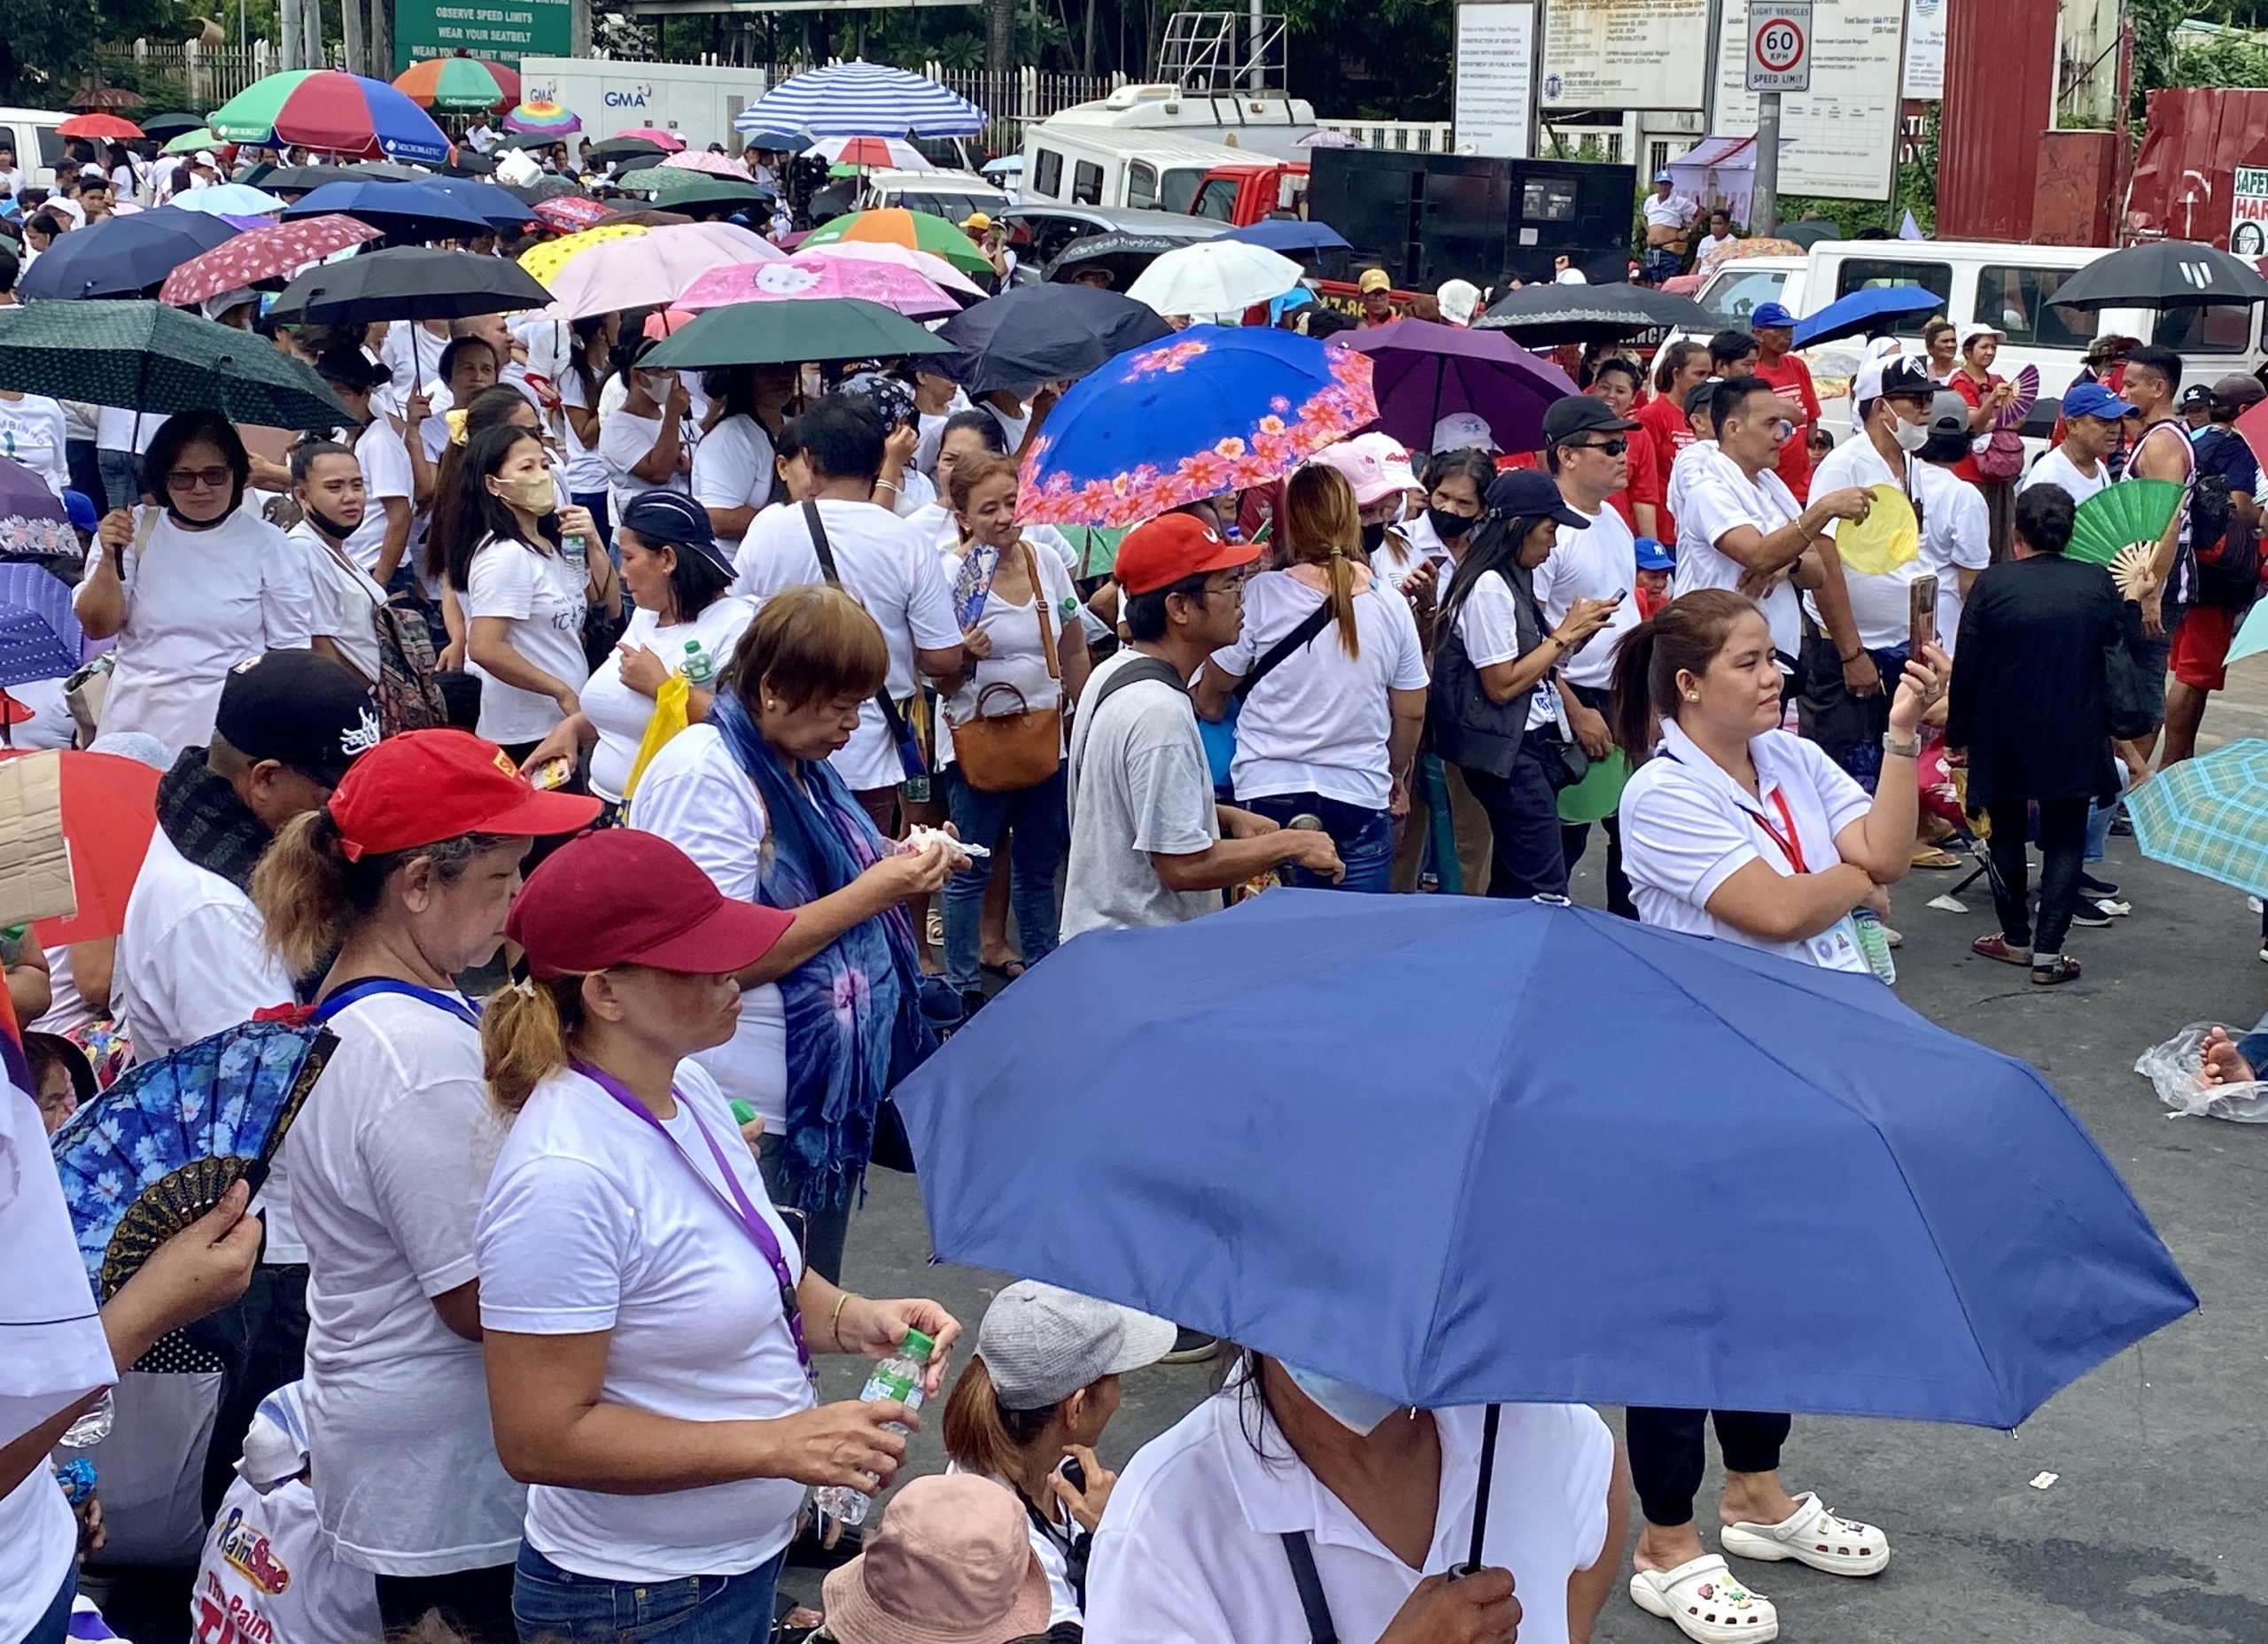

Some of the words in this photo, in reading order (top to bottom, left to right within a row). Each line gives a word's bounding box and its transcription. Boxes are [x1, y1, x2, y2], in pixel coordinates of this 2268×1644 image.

[436, 7, 474, 19] OBSERVE
[477, 8, 502, 21] SPEED
[505, 10, 532, 23] LIMITS
[438, 27, 462, 38] WEAR
[465, 28, 488, 40] YOUR
[491, 30, 531, 43] SEATBELT
[1767, 31, 1793, 50] 60
[412, 46, 437, 58] WEAR
[1753, 74, 1778, 83] SPEED
[1783, 74, 1803, 83] LIMIT
[531, 89, 554, 103] GMA
[604, 91, 646, 107] GMA
[399, 141, 441, 156] MICROMATIC
